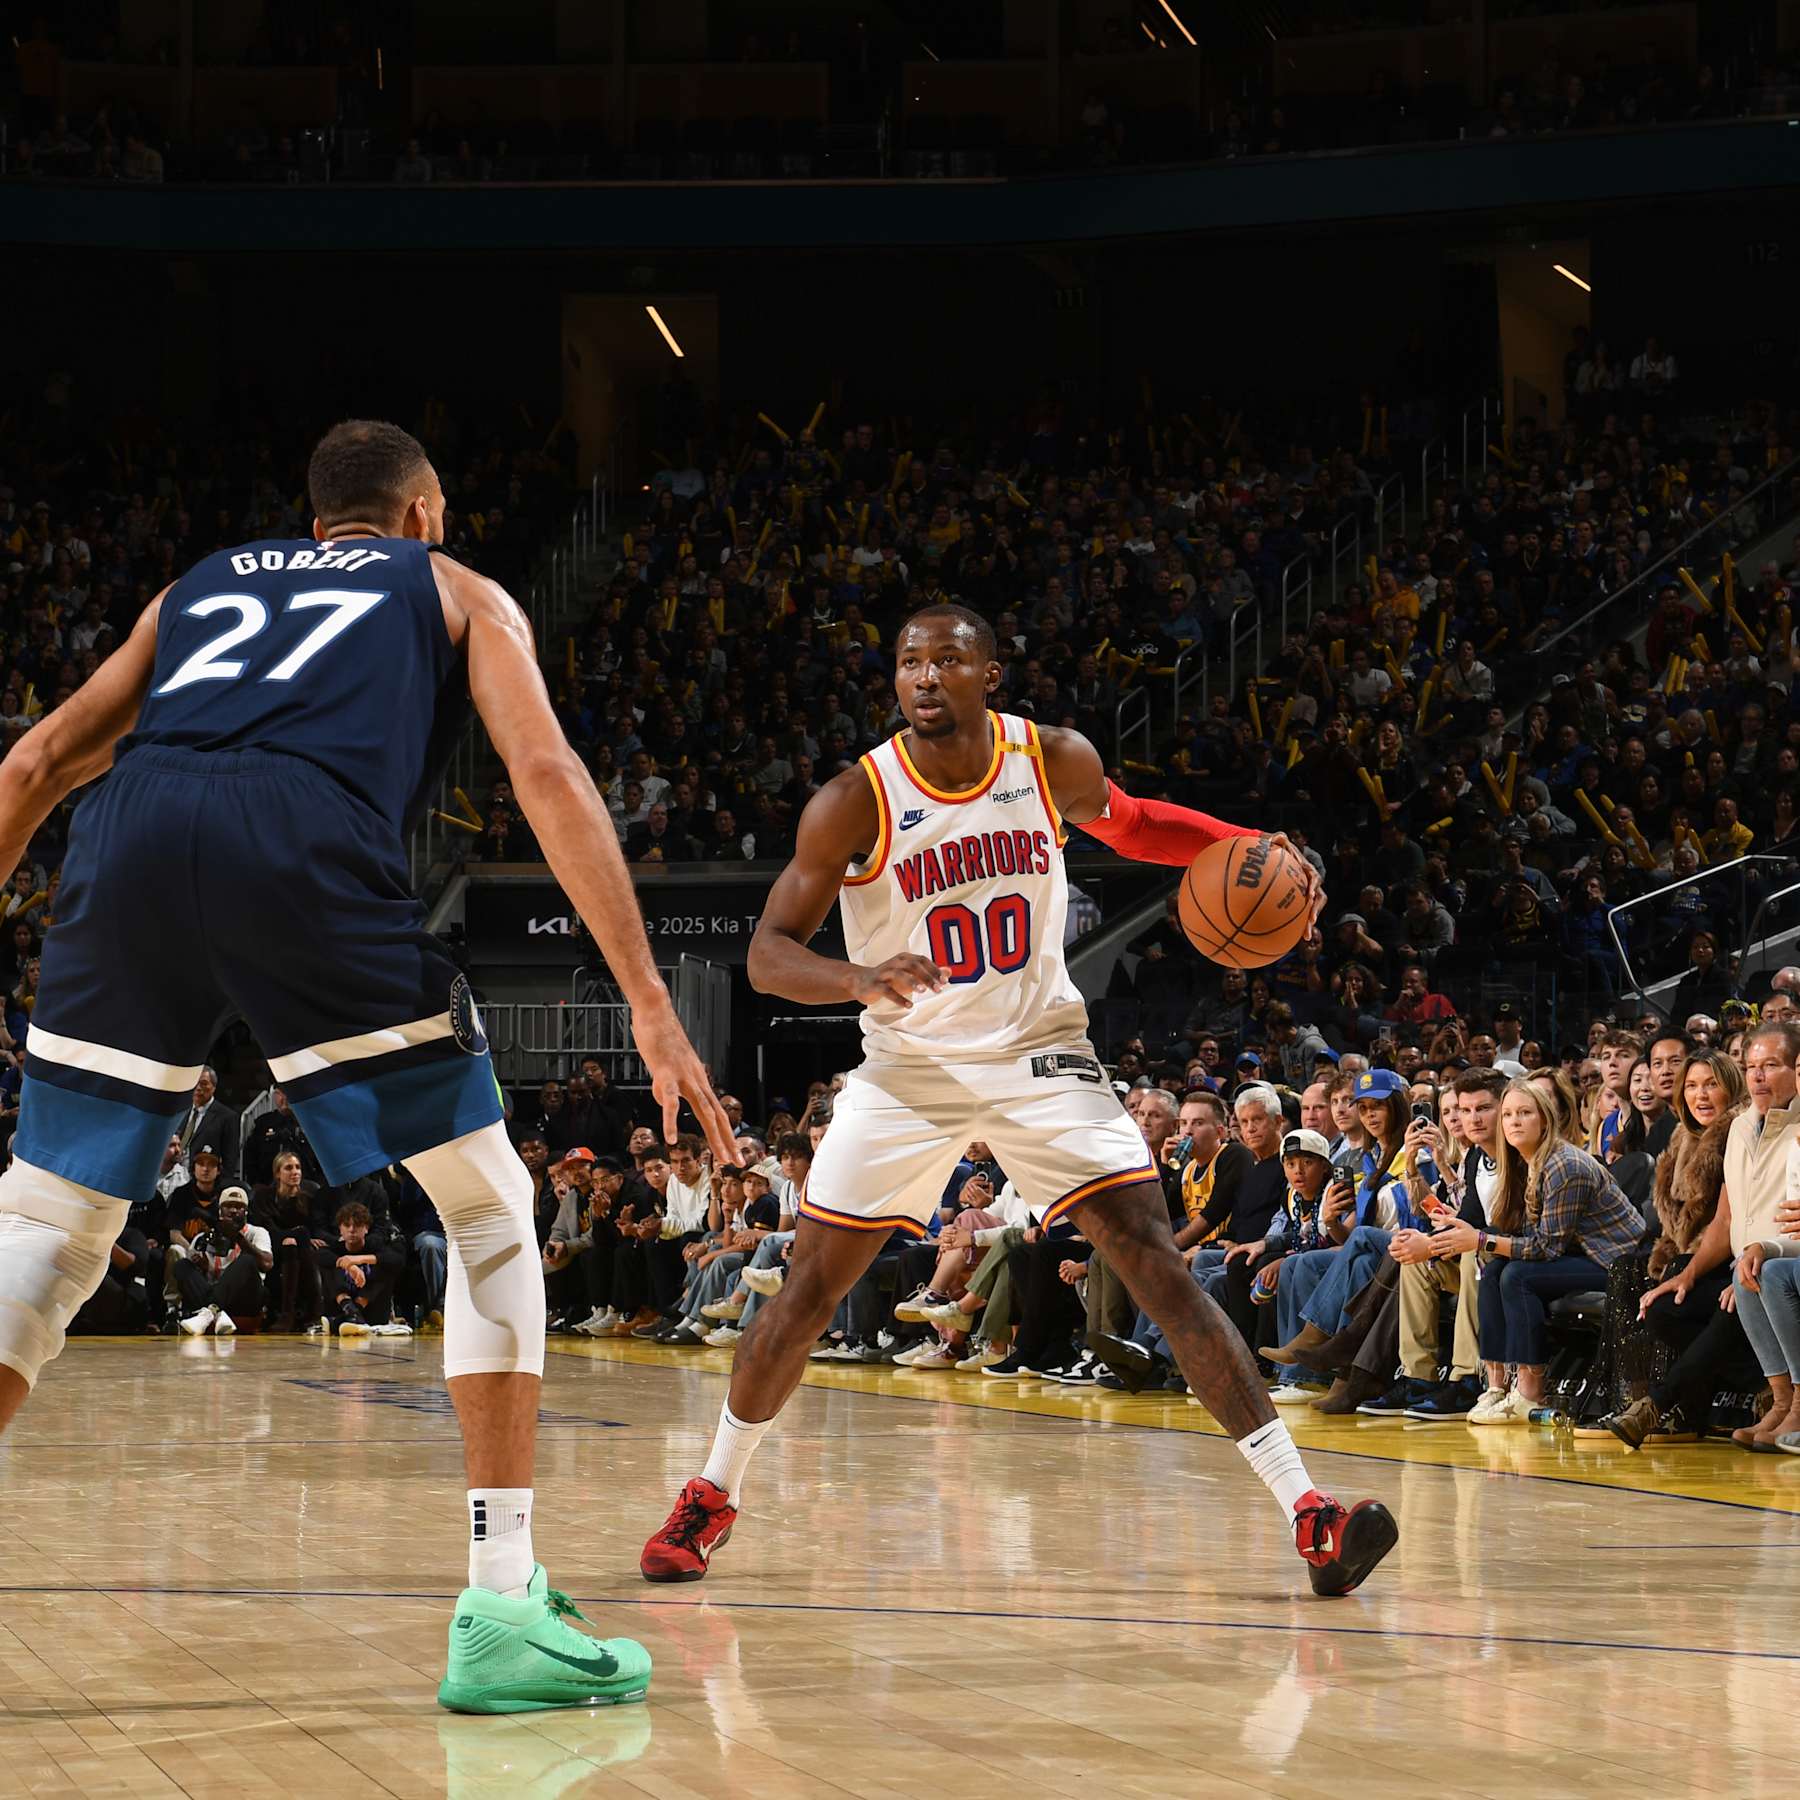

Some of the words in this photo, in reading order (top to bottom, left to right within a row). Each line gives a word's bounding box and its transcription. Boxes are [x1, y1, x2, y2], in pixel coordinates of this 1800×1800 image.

[230, 548, 392, 576] GOBERT
[150, 587, 391, 697] 27
[992, 786, 1034, 803] Rakuten
[903, 809, 925, 822] NIKE
[894, 830, 1049, 903] WARRIORS
[660, 917, 705, 934] 2025
[711, 916, 739, 934] Kia
[926, 893, 1031, 984] 00
